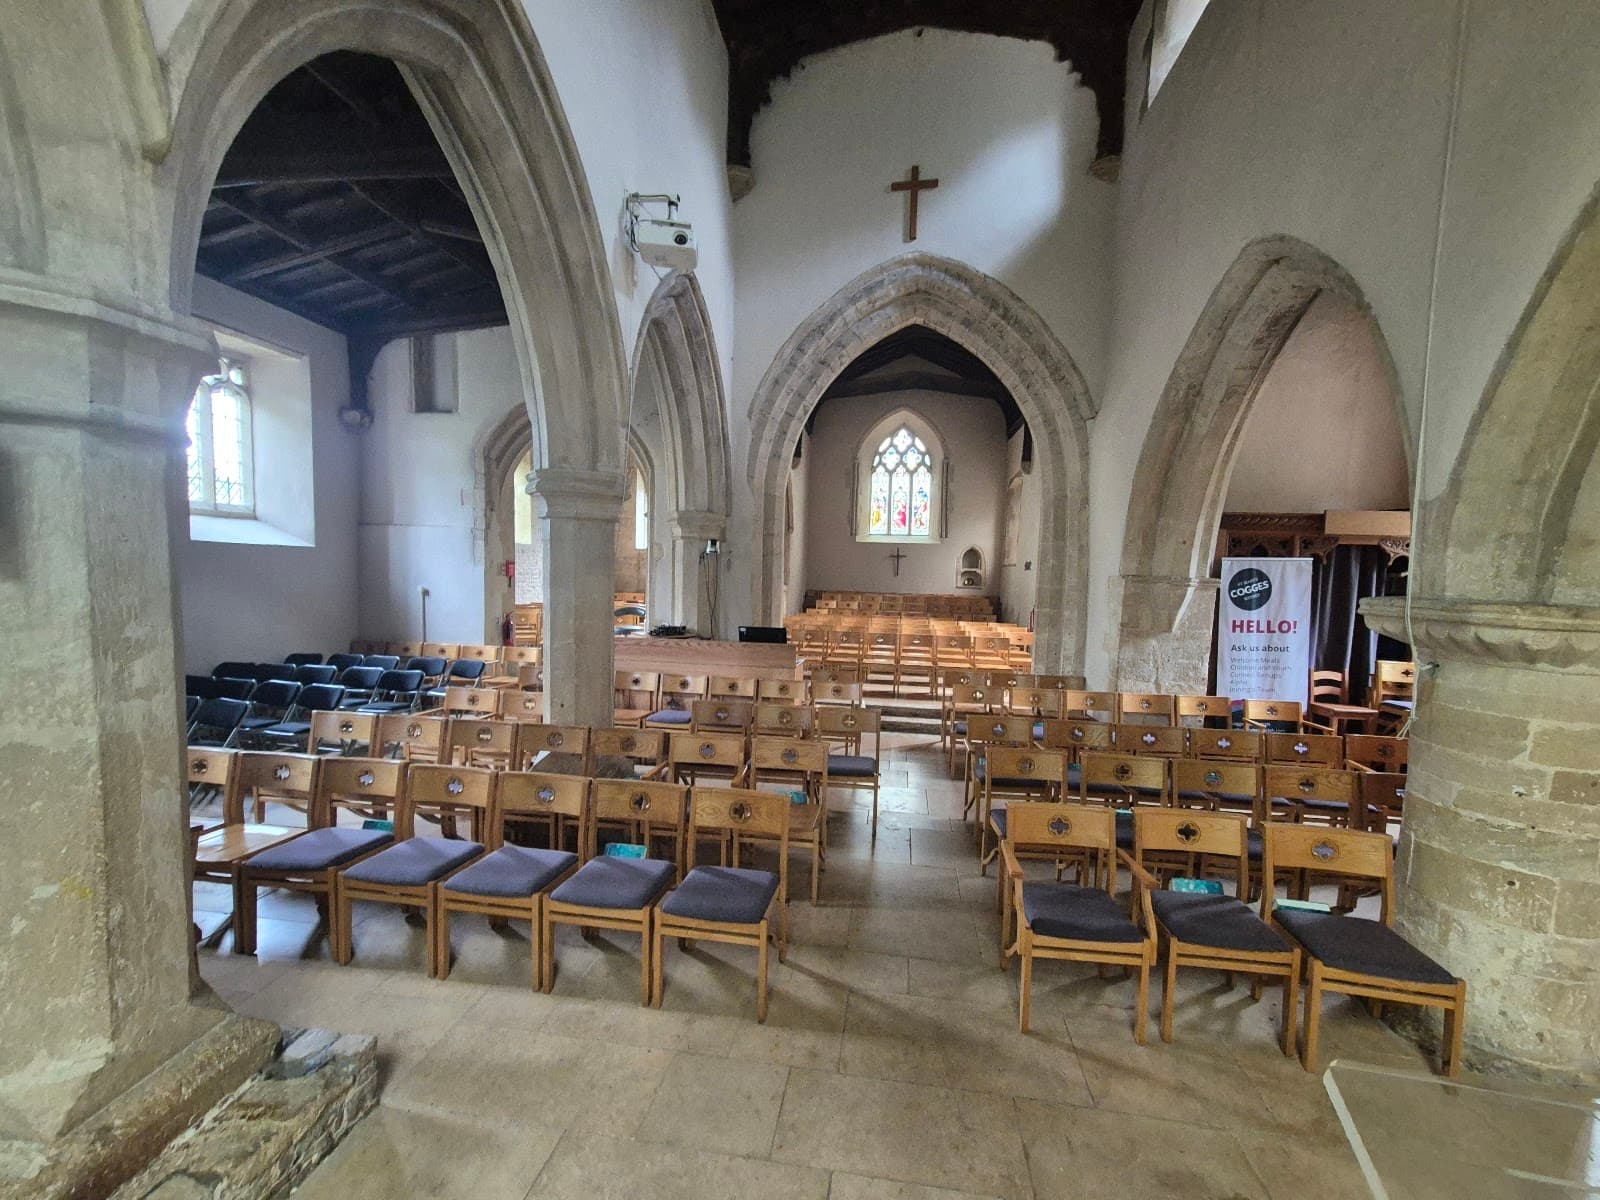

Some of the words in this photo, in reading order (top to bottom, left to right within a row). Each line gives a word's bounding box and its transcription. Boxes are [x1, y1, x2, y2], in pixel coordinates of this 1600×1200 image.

[1230, 580, 1269, 598] COGGES
[1232, 620, 1297, 634] HELLO!
[1231, 644, 1247, 652] Ask
[1261, 644, 1290, 652] about
